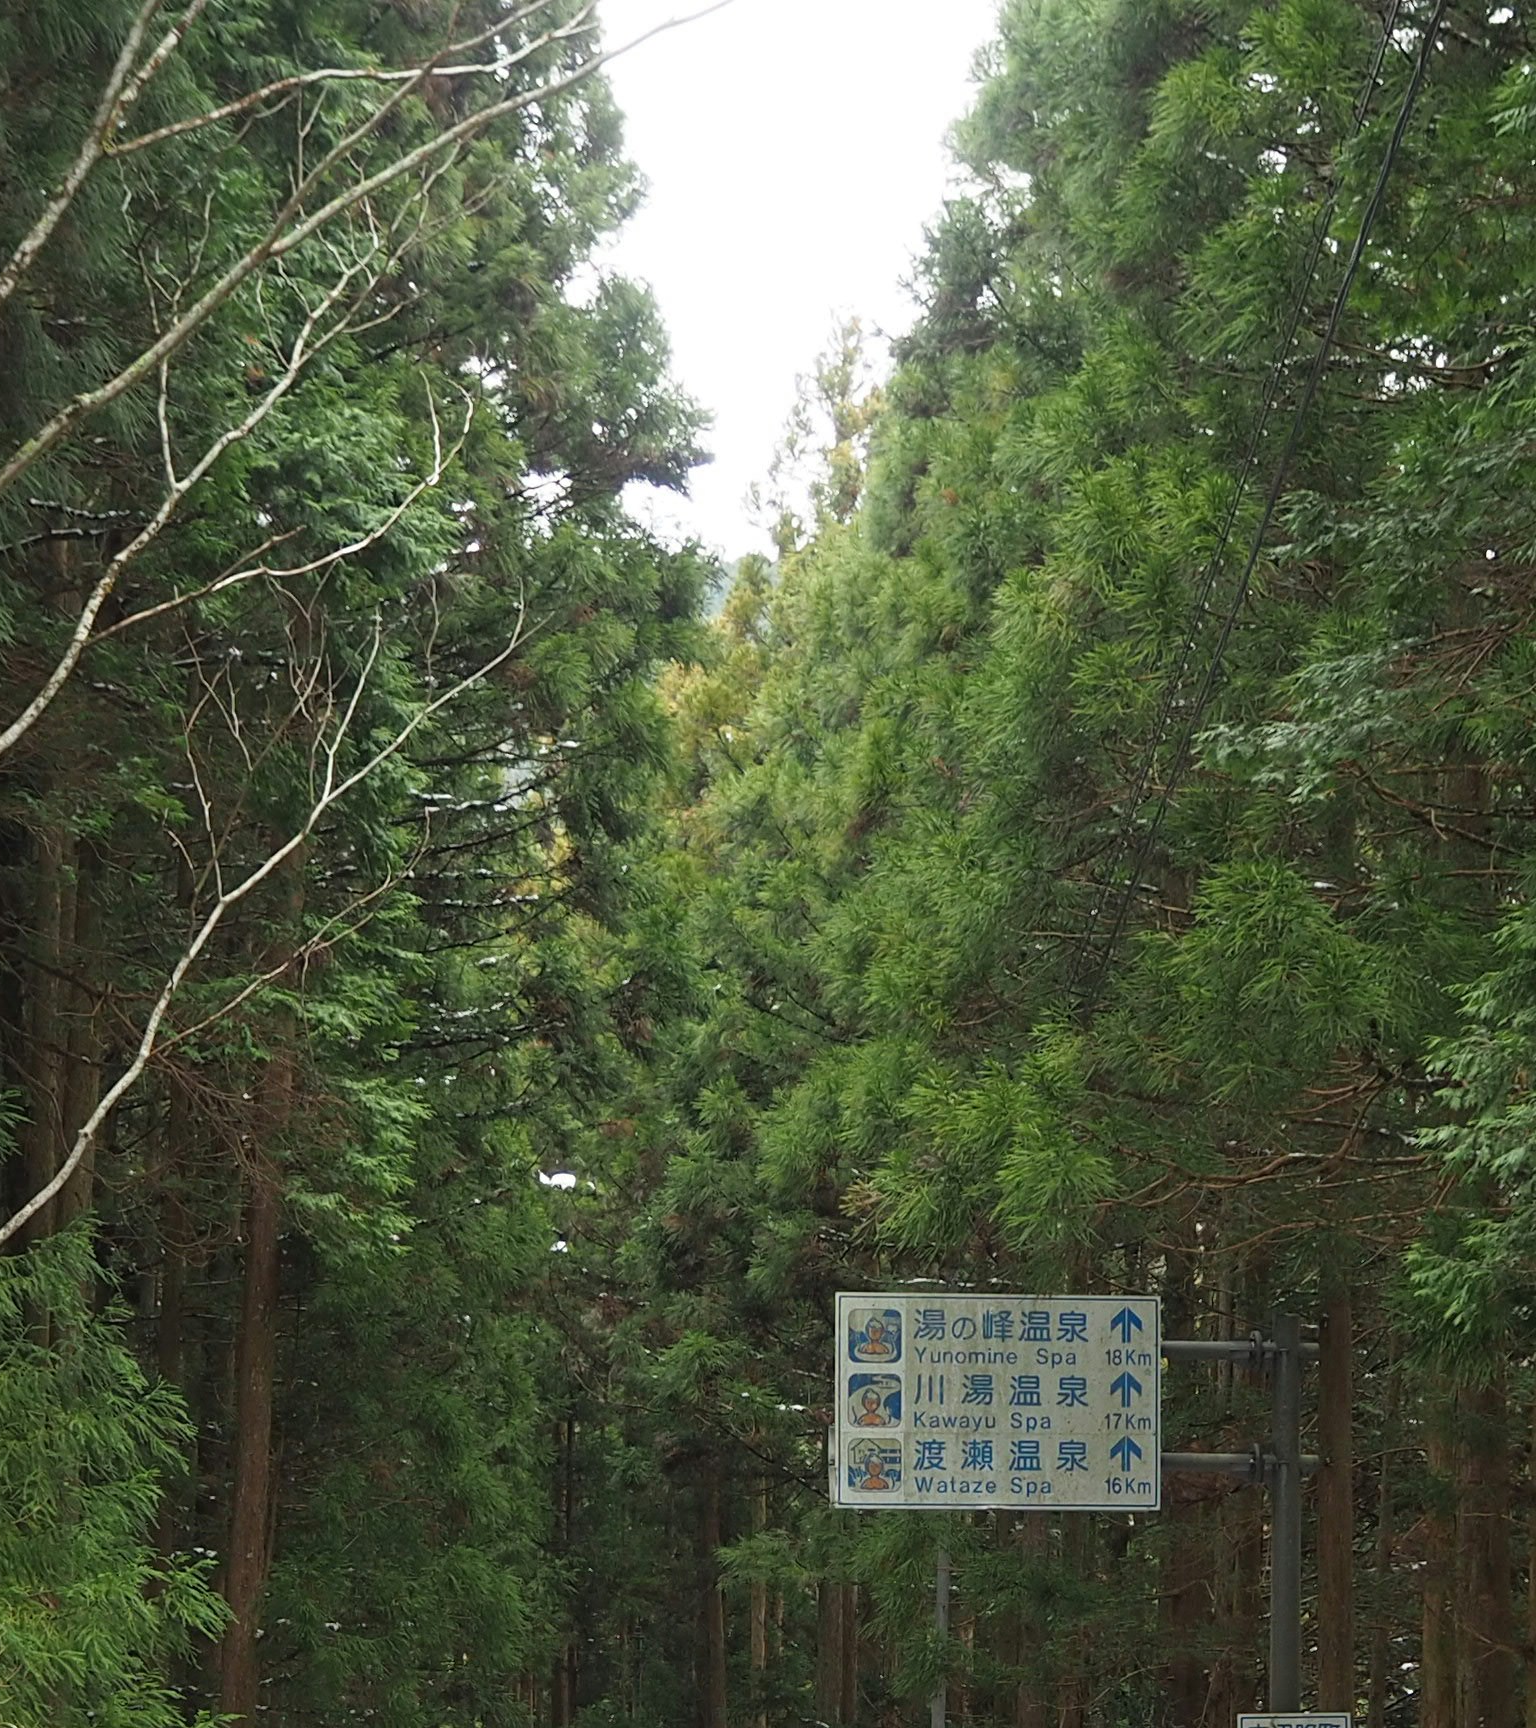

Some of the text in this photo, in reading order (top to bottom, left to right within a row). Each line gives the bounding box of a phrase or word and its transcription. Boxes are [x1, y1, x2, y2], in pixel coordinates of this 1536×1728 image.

[913, 1309, 1089, 1343] 湯の峰温泉
[915, 1348, 1076, 1368] Yunomine Spa
[913, 1374, 1089, 1407] 川湯温泉
[913, 1411, 1051, 1431] Kawayu Spa
[913, 1439, 1089, 1472] 渡瀬温泉
[915, 1477, 1052, 1496] Wataze Spa
